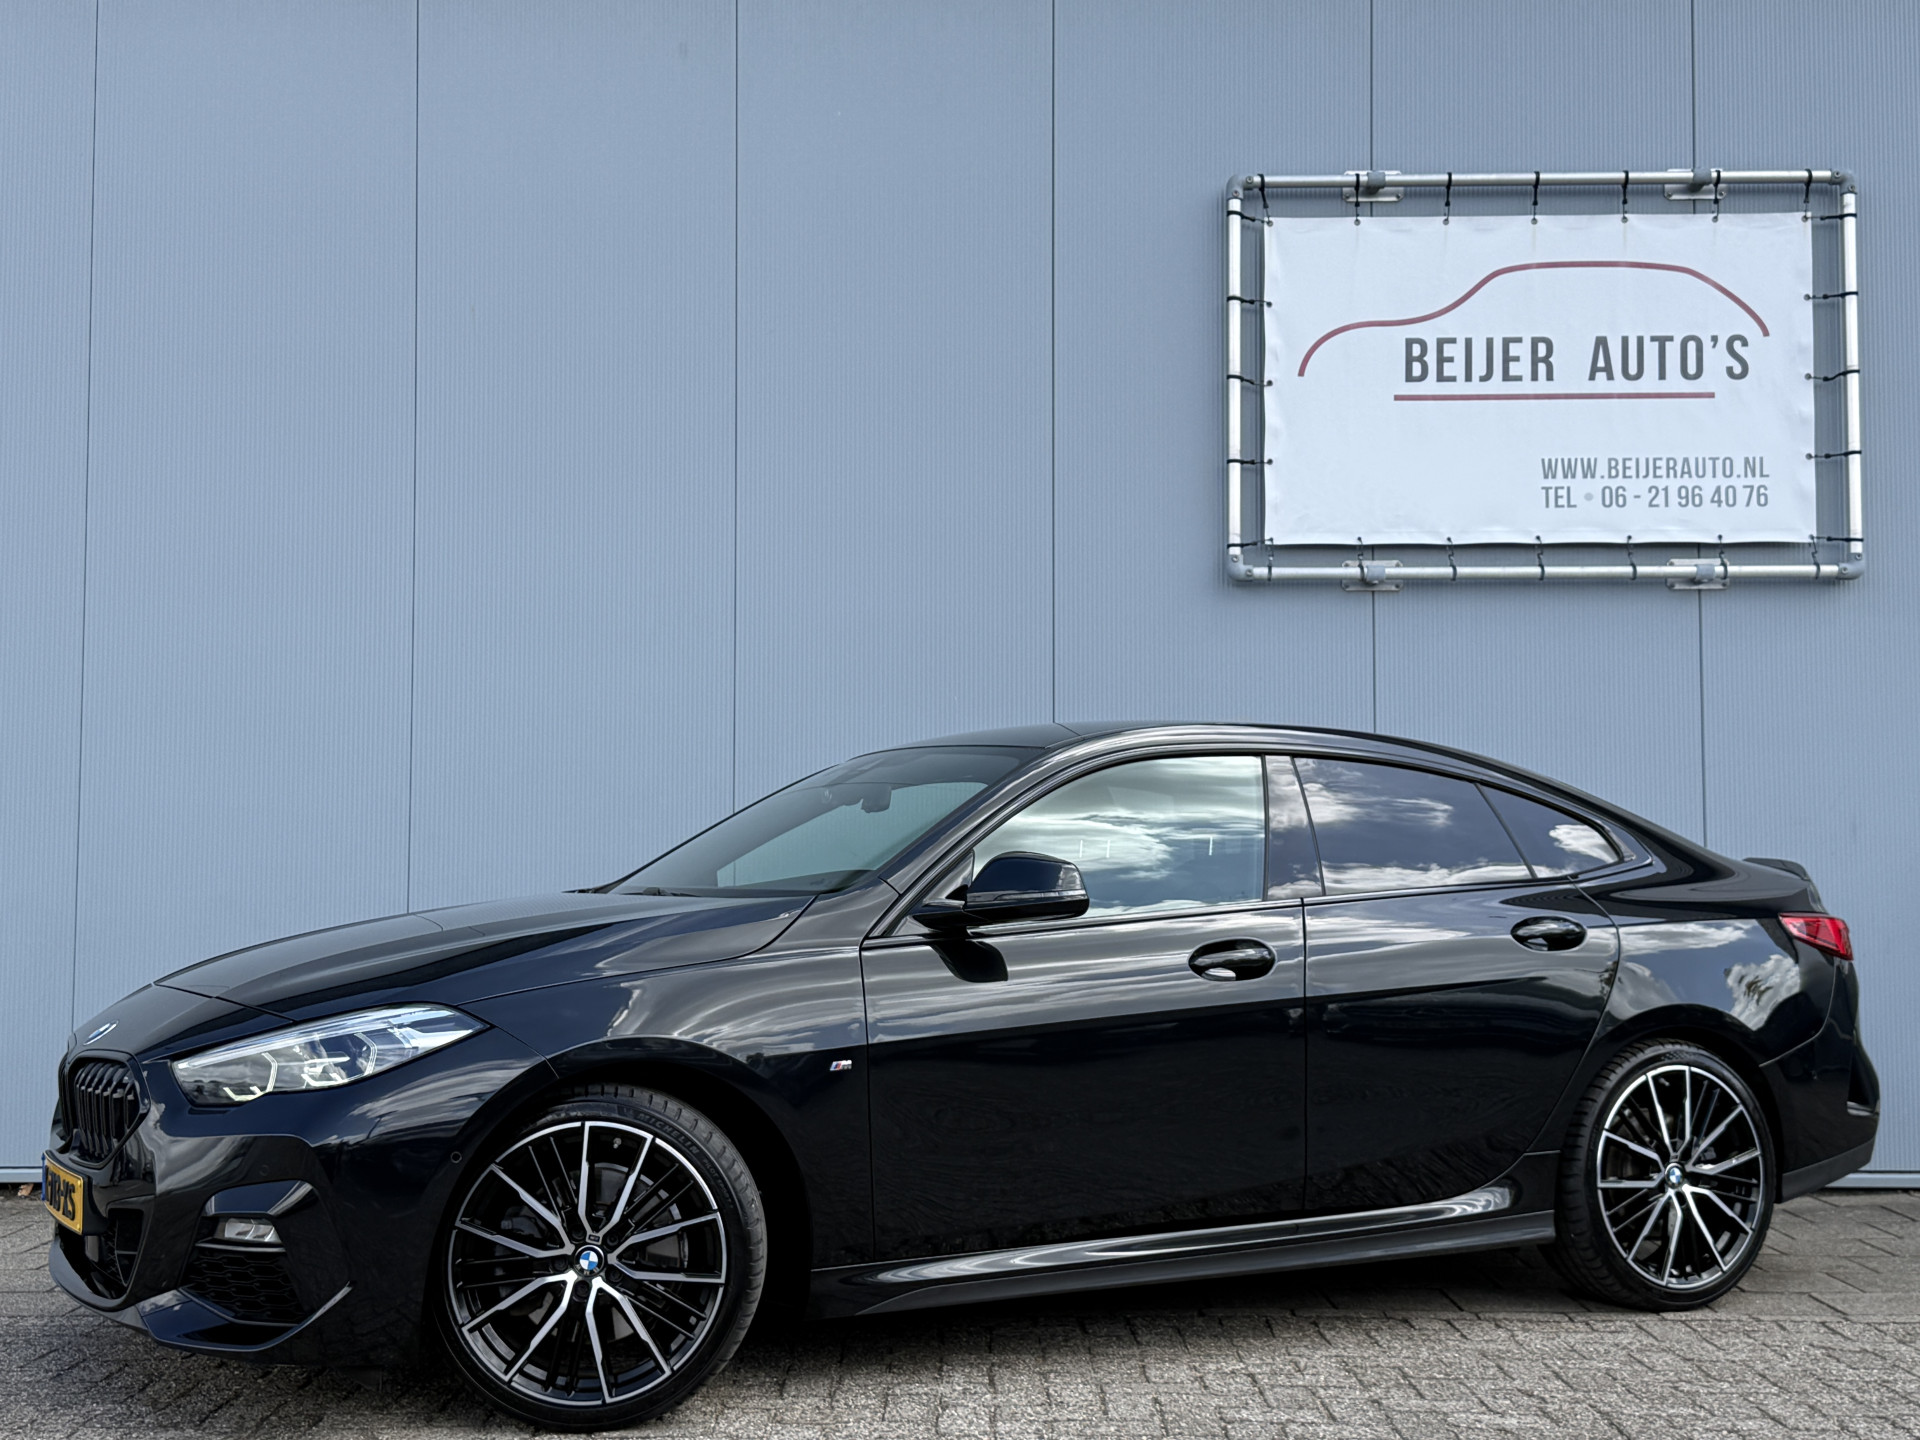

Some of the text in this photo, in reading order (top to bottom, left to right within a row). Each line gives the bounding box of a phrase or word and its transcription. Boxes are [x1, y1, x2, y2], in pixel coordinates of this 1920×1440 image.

[1404, 333, 1750, 383] BEIJER AUTO'S
[1541, 456, 1770, 480] WWW.BEIJERAUTO.NL
[1541, 486, 1577, 509] TEL
[1601, 485, 1627, 508] 06
[1647, 485, 1669, 508] 21
[1677, 485, 1703, 508] 96
[1710, 484, 1737, 508] 40
[1742, 484, 1769, 508] 76
[636, 1112, 701, 1155] MICHELIN
